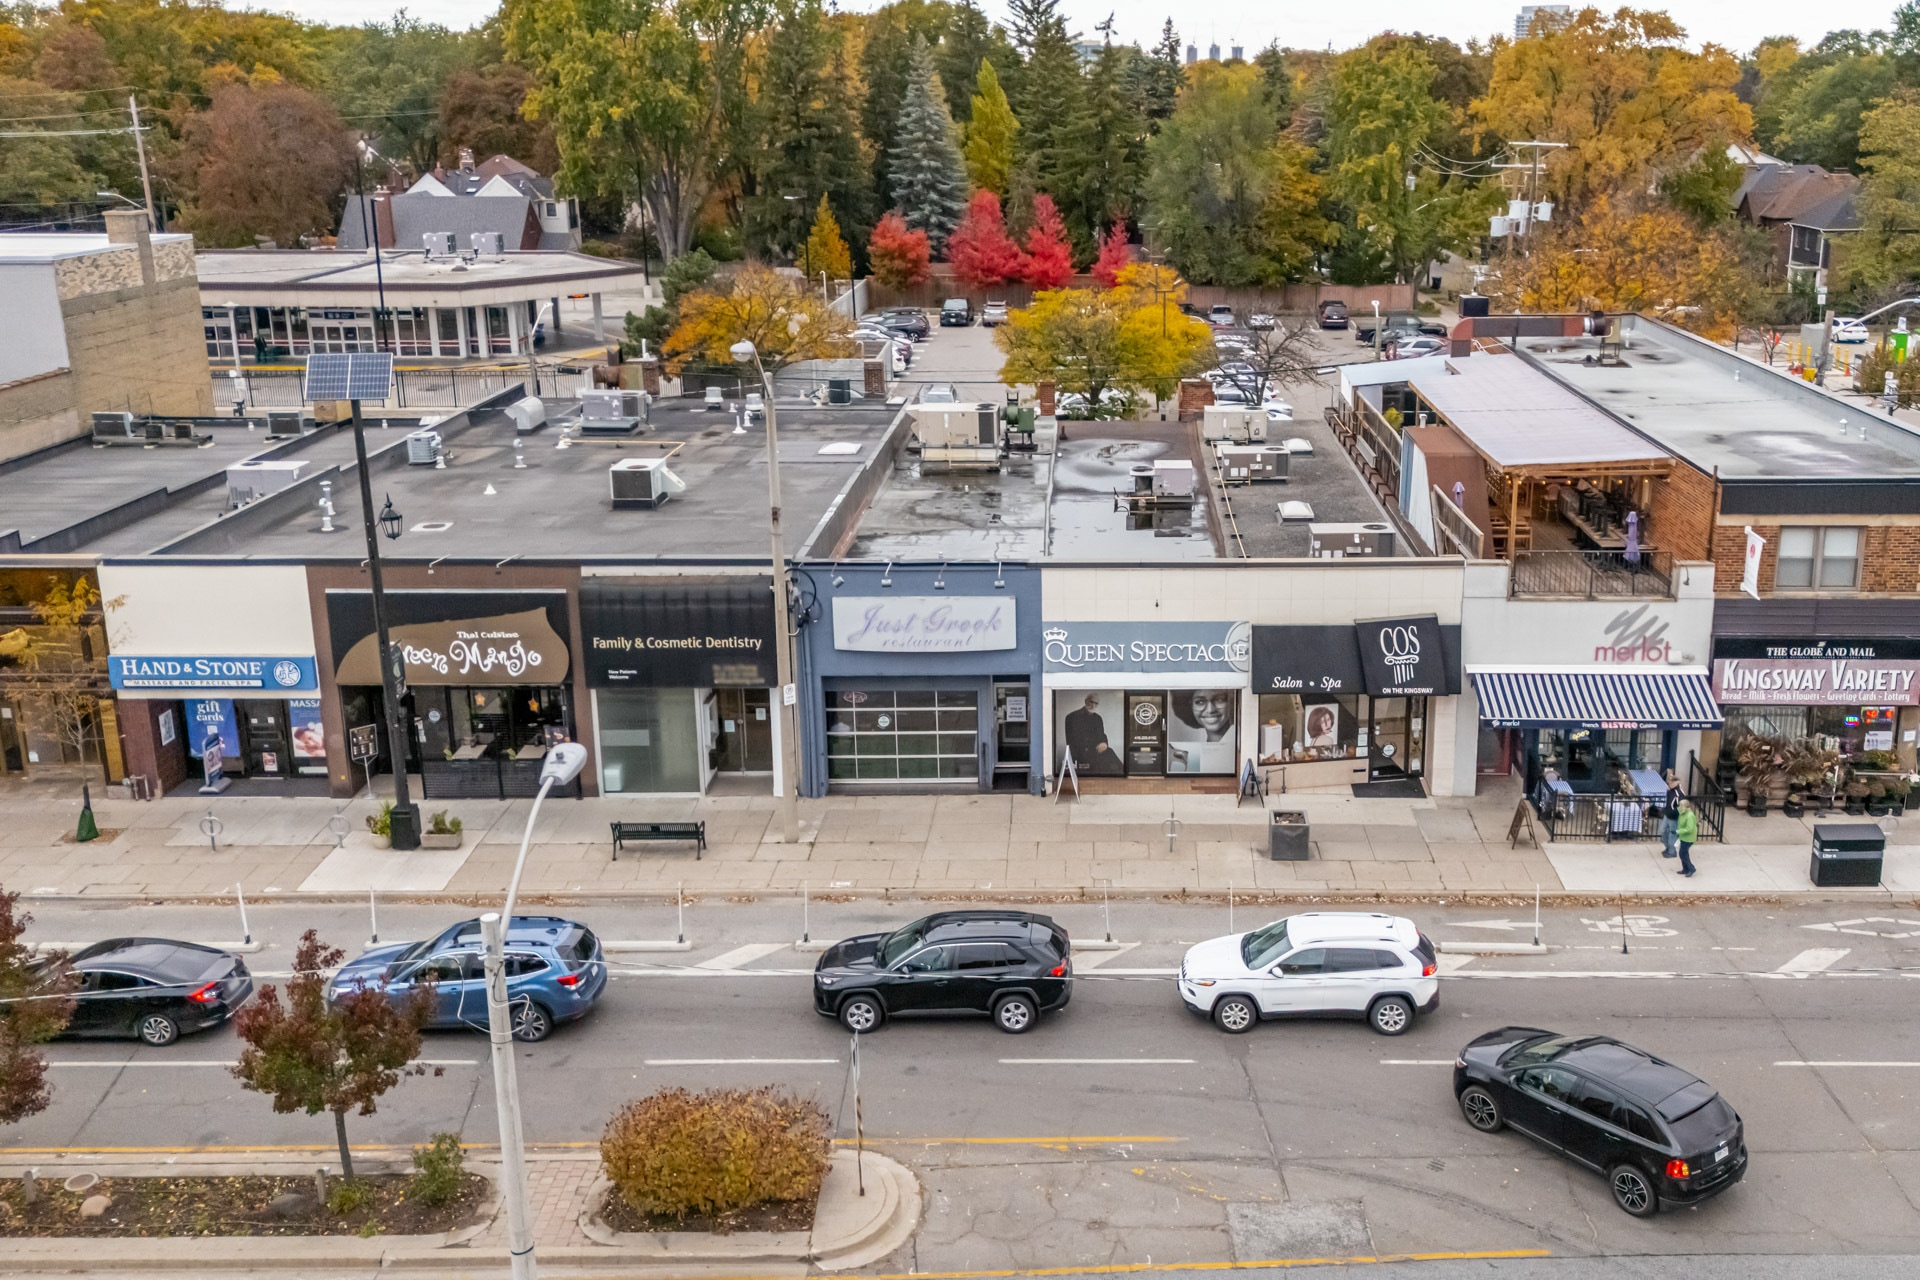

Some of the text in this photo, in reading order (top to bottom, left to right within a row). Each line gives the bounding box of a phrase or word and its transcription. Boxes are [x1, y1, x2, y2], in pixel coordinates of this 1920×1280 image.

[847, 604, 917, 643] Just
[456, 631, 520, 639] Thai Cuisine
[882, 634, 973, 647] restaurant
[1379, 625, 1420, 656] COS
[593, 636, 762, 651] Family & Cosmetic Dentistry
[1594, 636, 1672, 662] merlot
[389, 641, 449, 675] reen
[449, 640, 542, 677] Mango
[1045, 641, 1248, 668] QUEEN SPECTACLE
[1766, 647, 1876, 657] THE GLOBE AND MAIL
[120, 659, 263, 676] HAND & STONE
[1722, 659, 1916, 692] KINGSWAY VARIETY
[1272, 676, 1342, 691] Salon Spa
[1721, 691, 1742, 700] Bread
[1749, 691, 1766, 700] Milk
[1773, 691, 1791, 701] Fresh
[1792, 691, 1820, 701] Flowers
[1827, 691, 1856, 702] Greeting
[1858, 691, 1877, 701] Cards
[1884, 691, 1911, 702] Lottery
[197, 700, 221, 714] gift
[196, 713, 225, 721] cards
[1601, 721, 1638, 729] BISTRO
